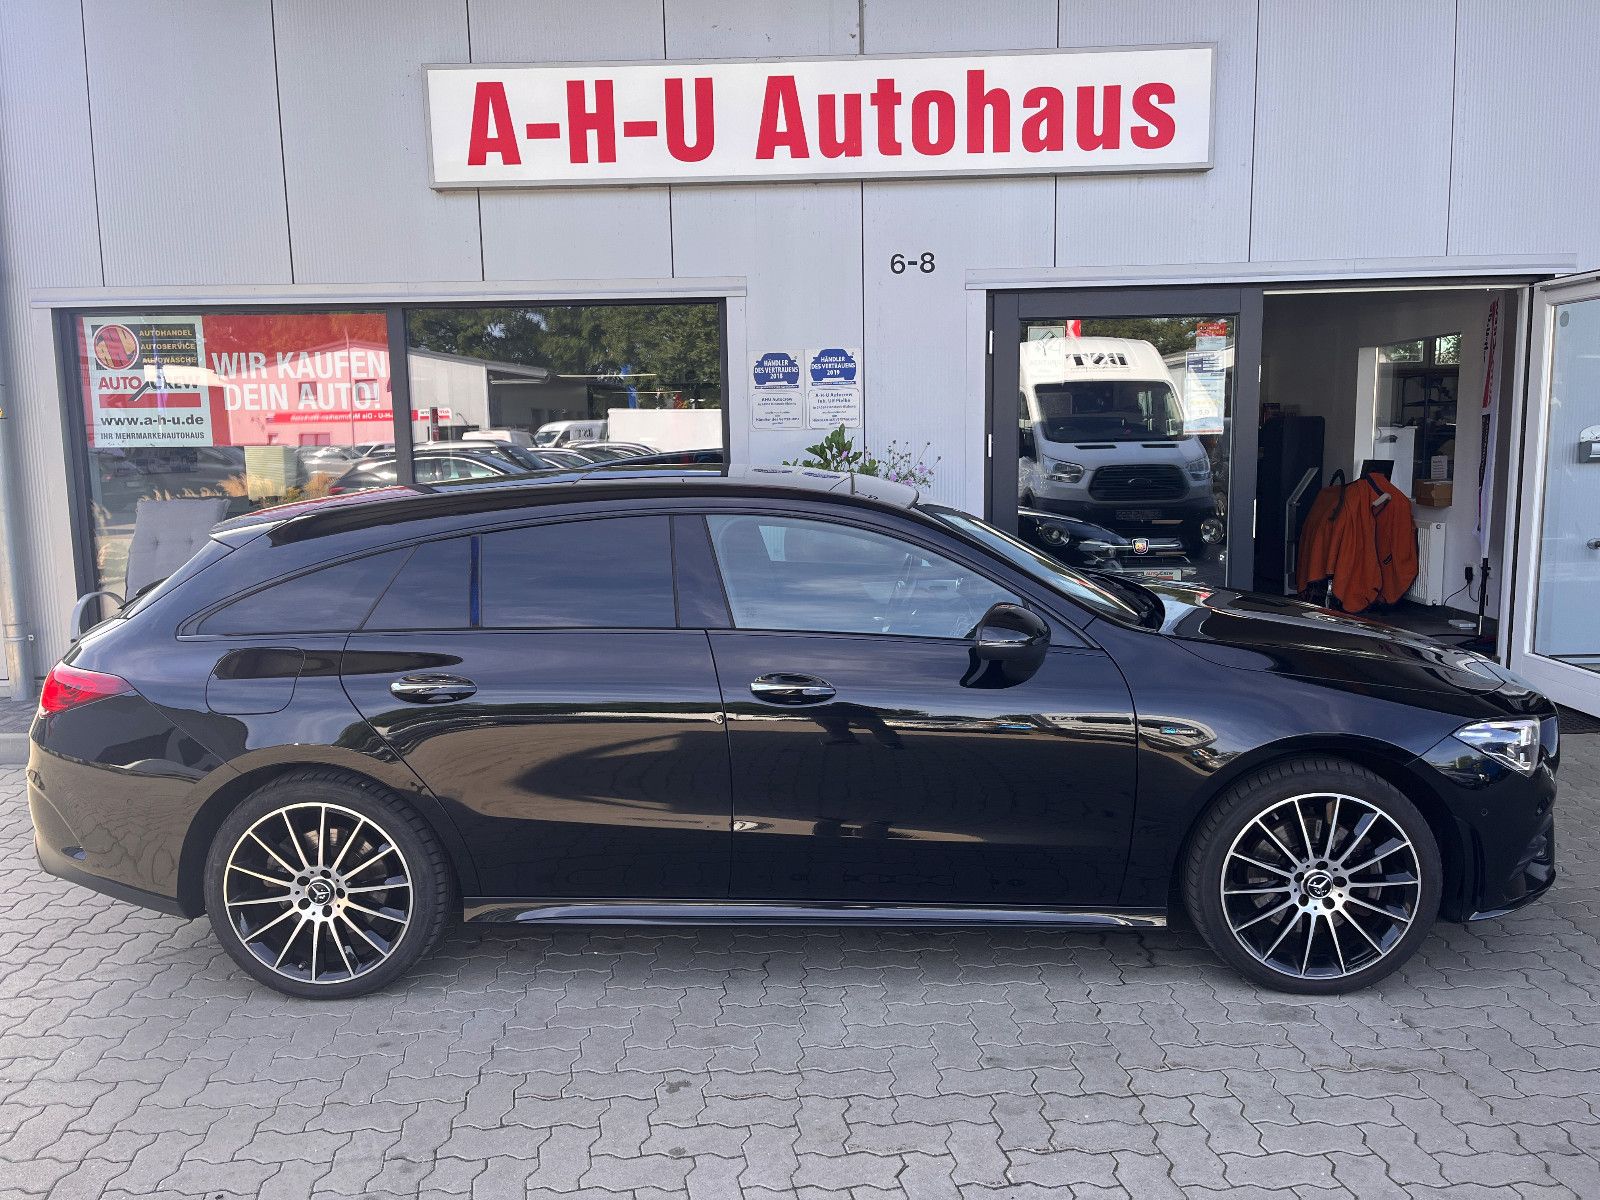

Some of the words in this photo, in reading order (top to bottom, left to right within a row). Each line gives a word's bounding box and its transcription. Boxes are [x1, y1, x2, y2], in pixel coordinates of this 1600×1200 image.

[467, 77, 715, 166] A-H-U
[755, 69, 1176, 160] Autohaus
[890, 252, 936, 275] 6-8
[139, 329, 192, 337] AUTOHANDEL
[141, 342, 196, 350] AUTOSERVICE
[211, 352, 268, 380] WIR
[276, 351, 387, 379] KAUFEN
[763, 359, 789, 367] HÄNDLER
[822, 361, 856, 369] VERTRAUENS
[765, 366, 799, 374] VERTRAUENS
[98, 376, 142, 390] AUTO
[224, 383, 289, 411] DEIN
[297, 382, 381, 410] AUTO!
[100, 414, 204, 426] www.a-h-u.de
[100, 432, 113, 440] IHR
[115, 431, 205, 440] MEHRMARKENAUTOHAUS
